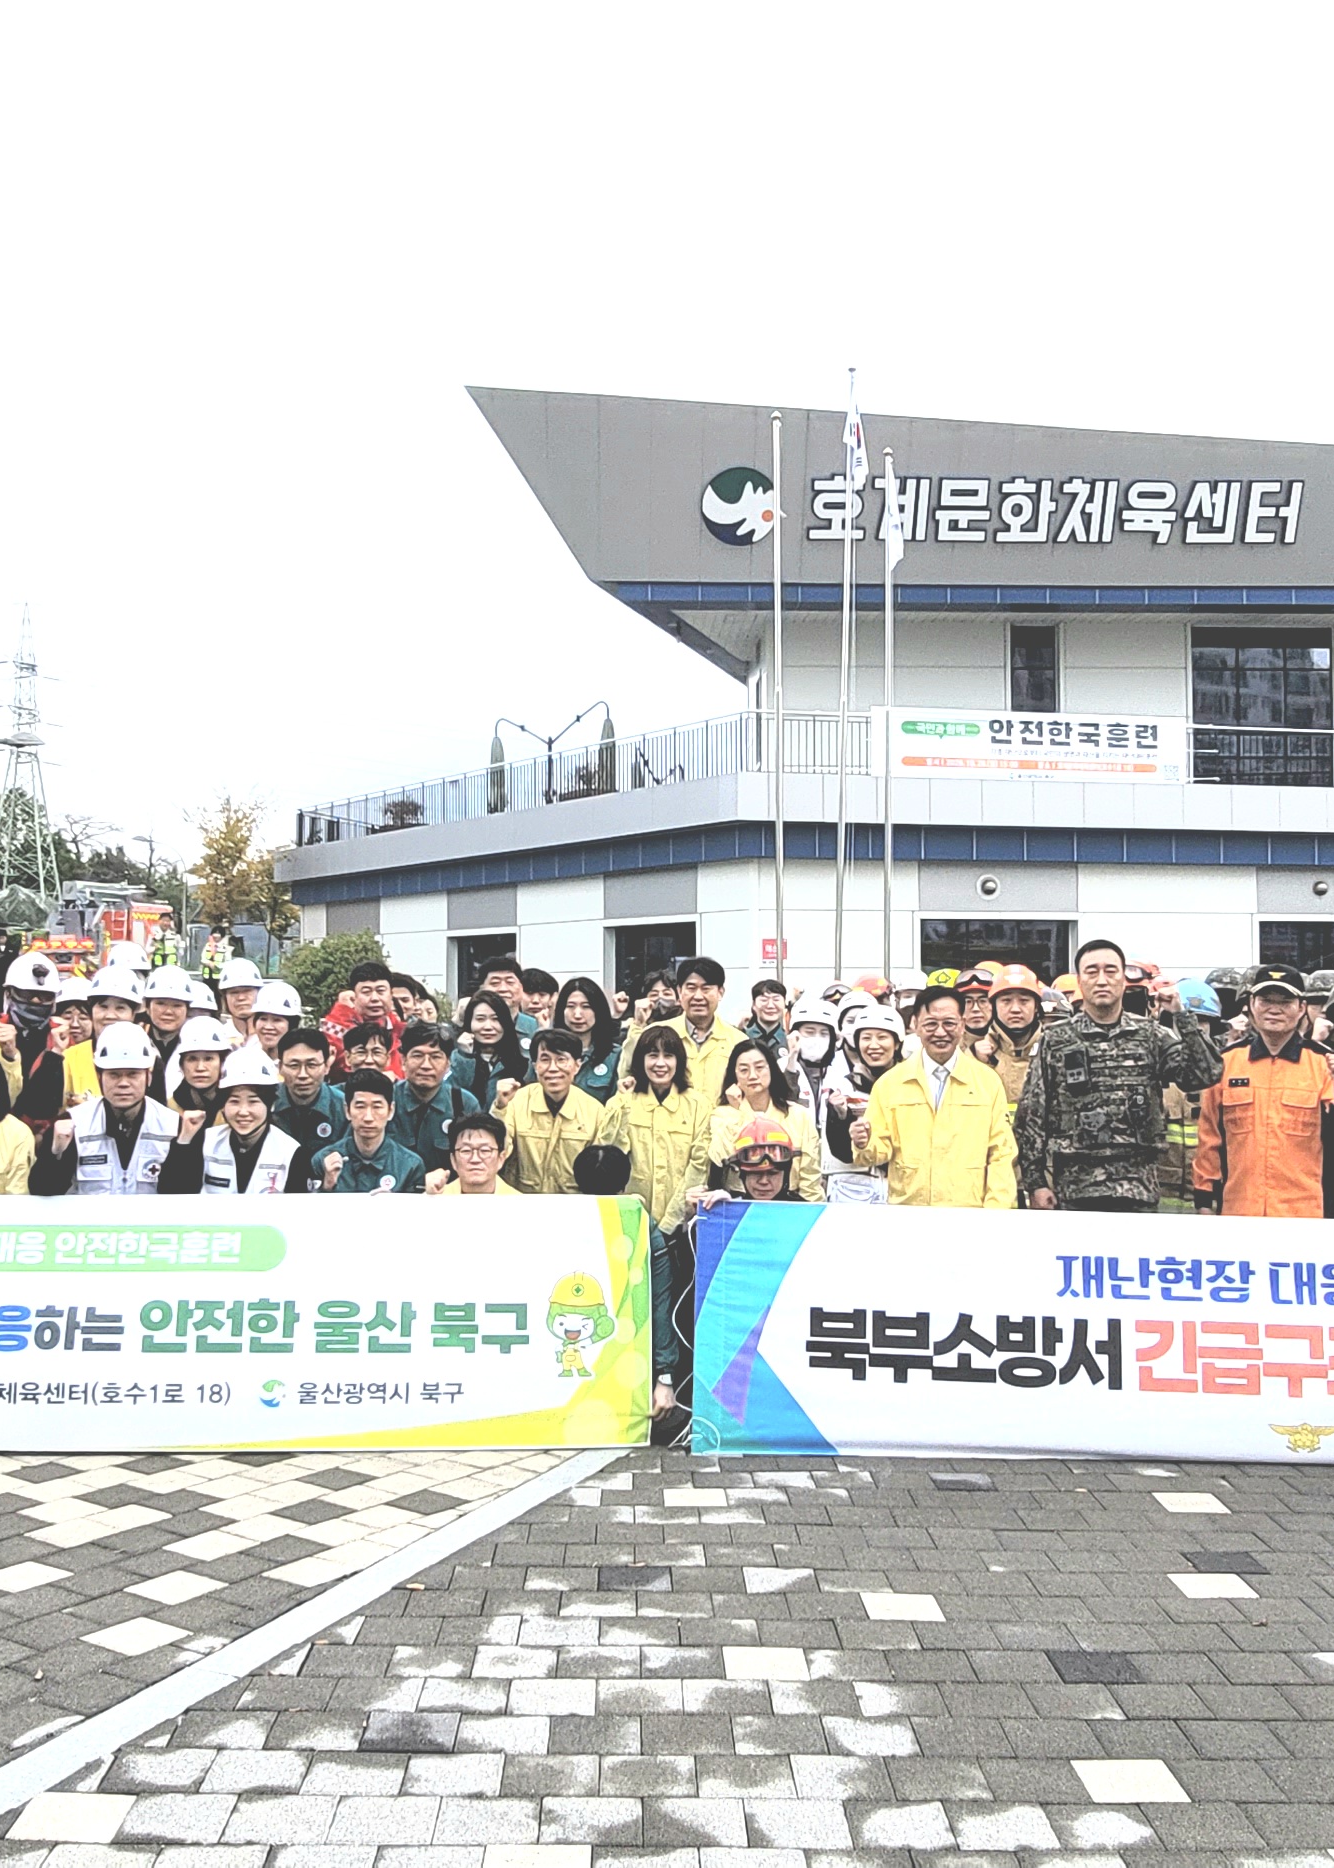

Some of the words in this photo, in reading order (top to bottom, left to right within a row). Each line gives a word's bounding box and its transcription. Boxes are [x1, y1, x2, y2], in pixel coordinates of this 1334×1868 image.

[807, 476, 1305, 544] 호계문화체육센터
[989, 719, 1159, 750] 안전한국훈련
[54, 1231, 242, 1265] 안전한국훈련
[1055, 1255, 1257, 1302] 재난현장
[139, 1298, 301, 1355] 안전한
[314, 1301, 418, 1355] 울산
[430, 1303, 531, 1356] 북구
[805, 1307, 1124, 1391] 북부소방서
[196, 1383, 232, 1406] 18)
[298, 1382, 411, 1406] 울산광역시
[419, 1383, 465, 1405] 북구
